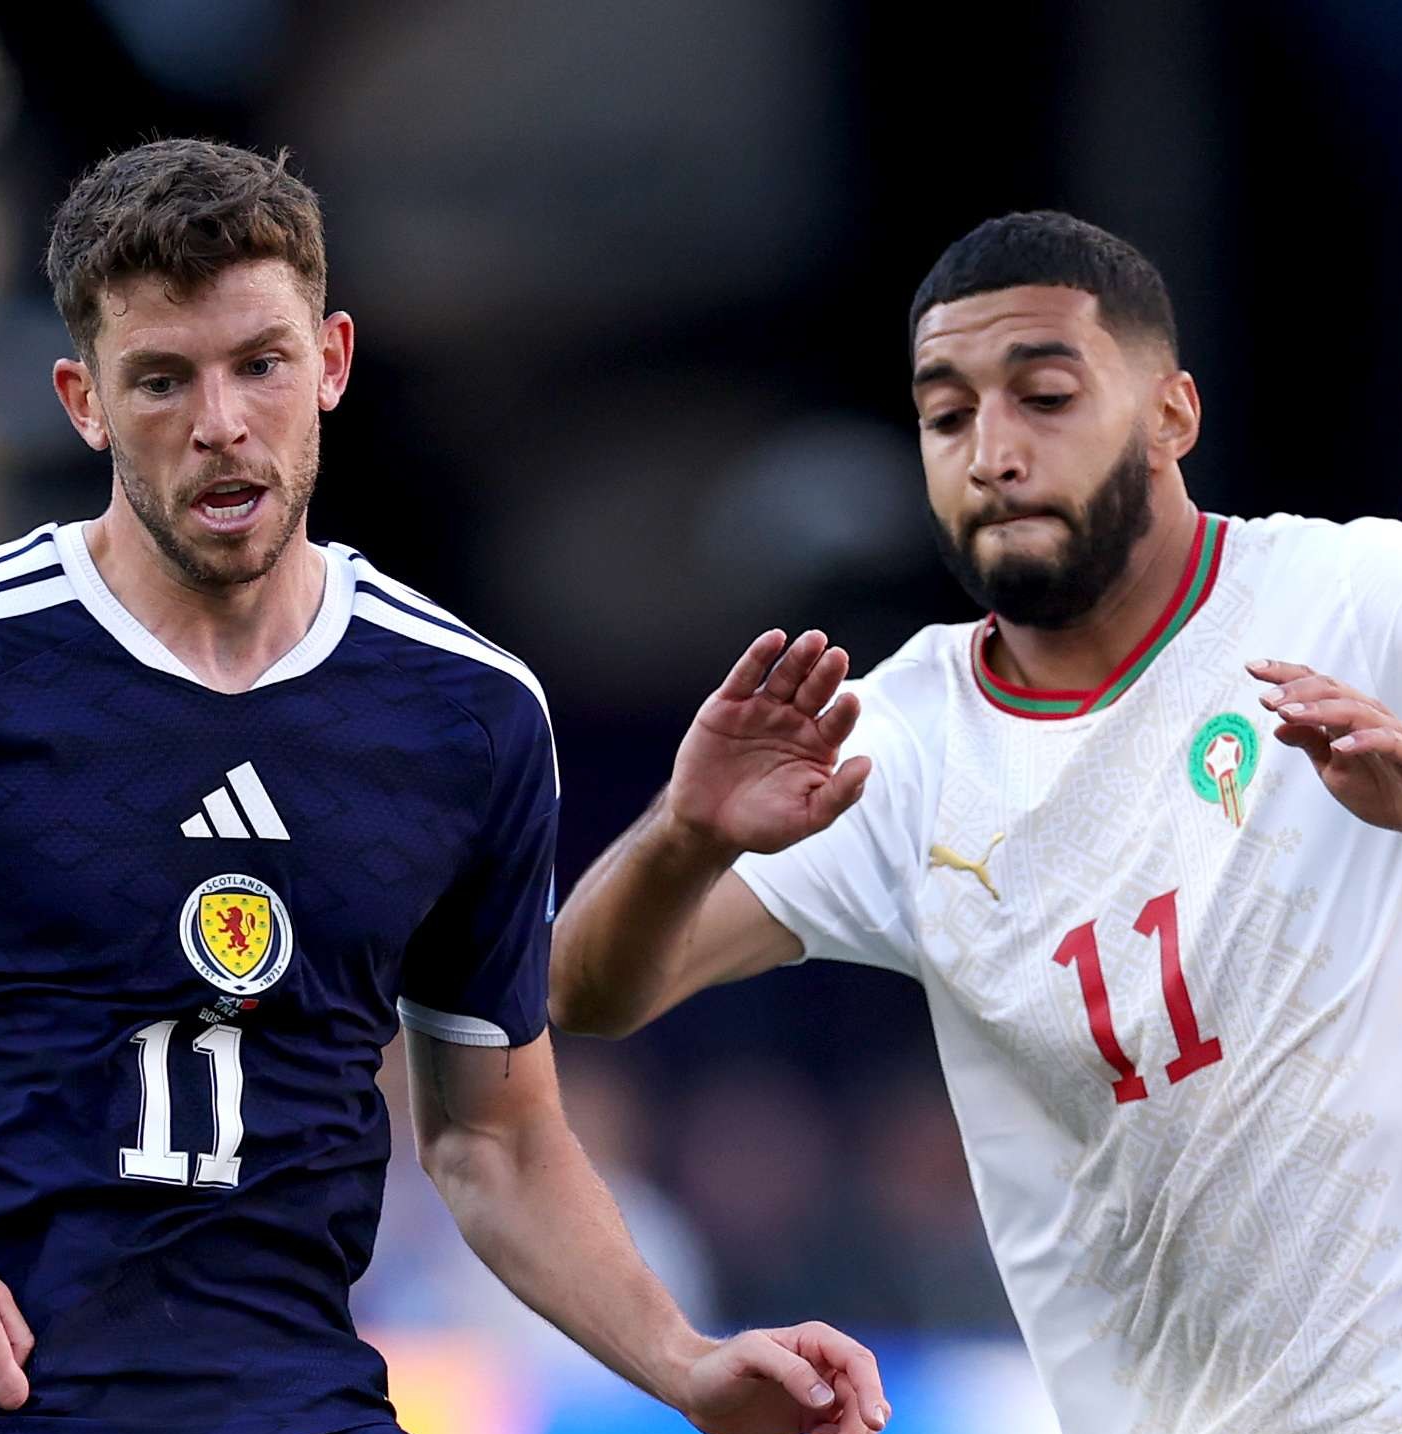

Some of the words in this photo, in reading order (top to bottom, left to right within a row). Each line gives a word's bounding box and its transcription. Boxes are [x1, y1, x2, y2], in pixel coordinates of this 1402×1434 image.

[206, 876, 263, 893] SCOTLAND
[200, 963, 216, 980] EST
[263, 967, 281, 985] 1873
[1052, 886, 1224, 1105] 11
[119, 1020, 245, 1190] 11
